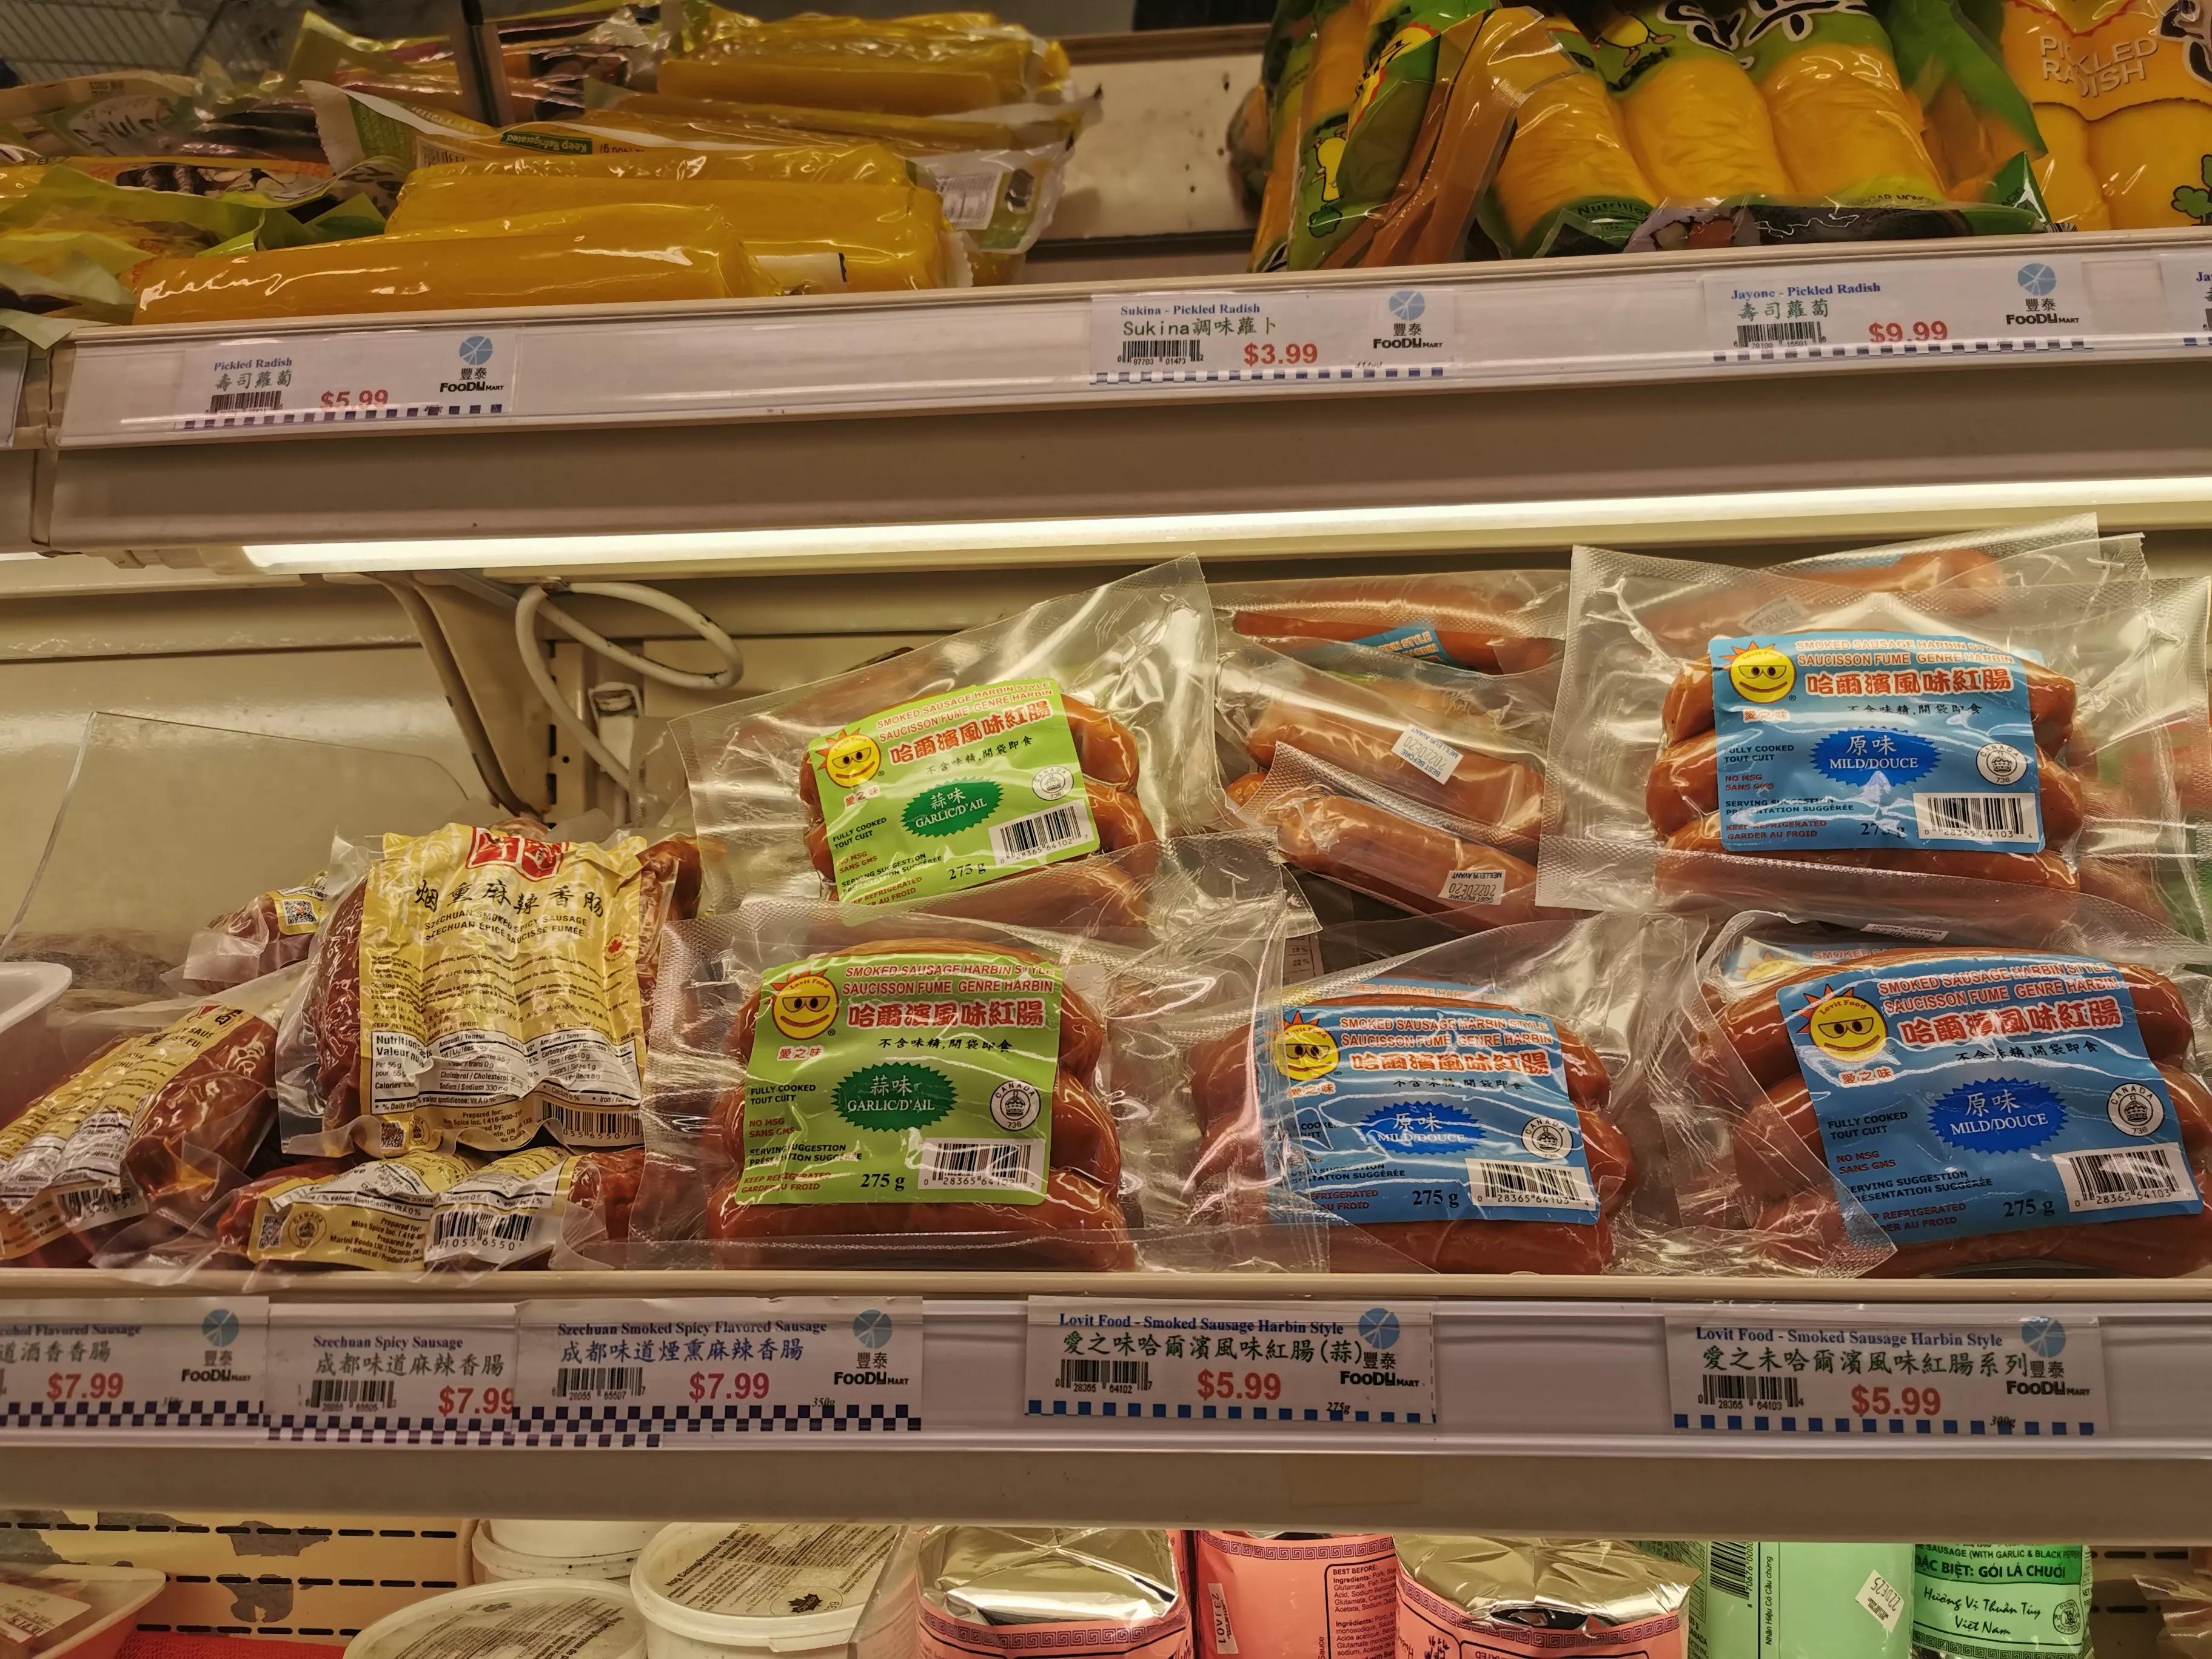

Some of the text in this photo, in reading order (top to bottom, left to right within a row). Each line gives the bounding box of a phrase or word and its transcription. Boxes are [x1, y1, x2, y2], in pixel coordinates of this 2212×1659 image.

[507, 134, 588, 153] Keep Refrigerated
[1731, 283, 1881, 302] Jayone Pickled Radish
[1121, 303, 1260, 316] Sukina Pickled Radish
[2025, 298, 2056, 312] 豐泰
[1393, 323, 1422, 337] 豐泰
[1869, 321, 1948, 344] $9.99
[214, 357, 292, 372] Pickled Radish
[1243, 343, 1318, 366] $3.99
[460, 367, 487, 380] 豐泰
[320, 389, 389, 411] $5.99
[1797, 651, 2016, 667] SAUCISSON FUME GENRE HARBIN
[1805, 666, 2014, 697] 哈爾濱風味紅腸
[876, 682, 1050, 729] SMOKED SAUSAGE HARBIN STYLE
[879, 688, 1053, 743] SAUCISSON FUME GENRE HARBIN
[889, 699, 1053, 766] 哈爾濱風味紅腸
[1845, 734, 1898, 756] 原味
[1423, 761, 1442, 780] BEST
[1828, 756, 1920, 770] MILD/DOUCE
[930, 786, 967, 811] 蒜味
[476, 911, 512, 930] SMOKED
[514, 919, 538, 933] SPICY
[543, 915, 588, 927] SAUSAGE
[506, 926, 548, 945] SAUCISSE
[552, 925, 584, 937] FUMÉE
[842, 979, 1054, 996] SAUCISSON FUME GENRE HARBIN
[1878, 961, 2111, 995] SMOKED SAUSAGE HARBIN STYLE
[1883, 976, 2120, 1016] SAUCISSON FUME GENRE HARBIN
[847, 999, 1045, 1029] 哈爾濱風味紅腸
[1899, 995, 2122, 1047] 哈爾濱風味紅腸
[1341, 1031, 1553, 1048] SAUCISSON FUME GENRE HARBIN
[377, 1047, 409, 1058] Valeur
[778, 1047, 822, 1061] 愛之味
[870, 1076, 913, 1097] 蒜味
[1841, 1067, 1892, 1085] 愛之味
[1964, 1089, 2022, 1118] 原味
[1393, 1112, 1443, 1133] 原味
[1949, 1111, 2050, 1137] MILD/DOUCE
[860, 1173, 905, 1193] 275 g
[557, 1320, 827, 1337] Szechuan Smoked Spicy Flavored Sausage
[1060, 1313, 1344, 1337] Lovit Food Smoked Sausage Harbin Style
[313, 1336, 463, 1352] Szechuan Spicy Sausage
[1696, 1327, 2003, 1350] Lovit Food Smoked Sausage Harbin Style
[856, 1351, 888, 1369] 豐泰
[1363, 1351, 1396, 1370] 豐泰
[47, 1372, 124, 1403] $7.99
[689, 1371, 770, 1403] $7.99
[1198, 1369, 1281, 1401] $5.99
[438, 1386, 514, 1417] $7.99
[1851, 1383, 1941, 1418] $5.99
[1926, 1544, 1967, 1558] SAUSAGE
[1969, 1548, 1994, 1560] (WITH
[1996, 1549, 2025, 1559] GARLIC
[2034, 1549, 2062, 1559] BLACK
[1978, 1563, 2003, 1578] GÓI
[2006, 1561, 2023, 1577] LÁ
[1981, 1621, 2011, 1636] Nam
